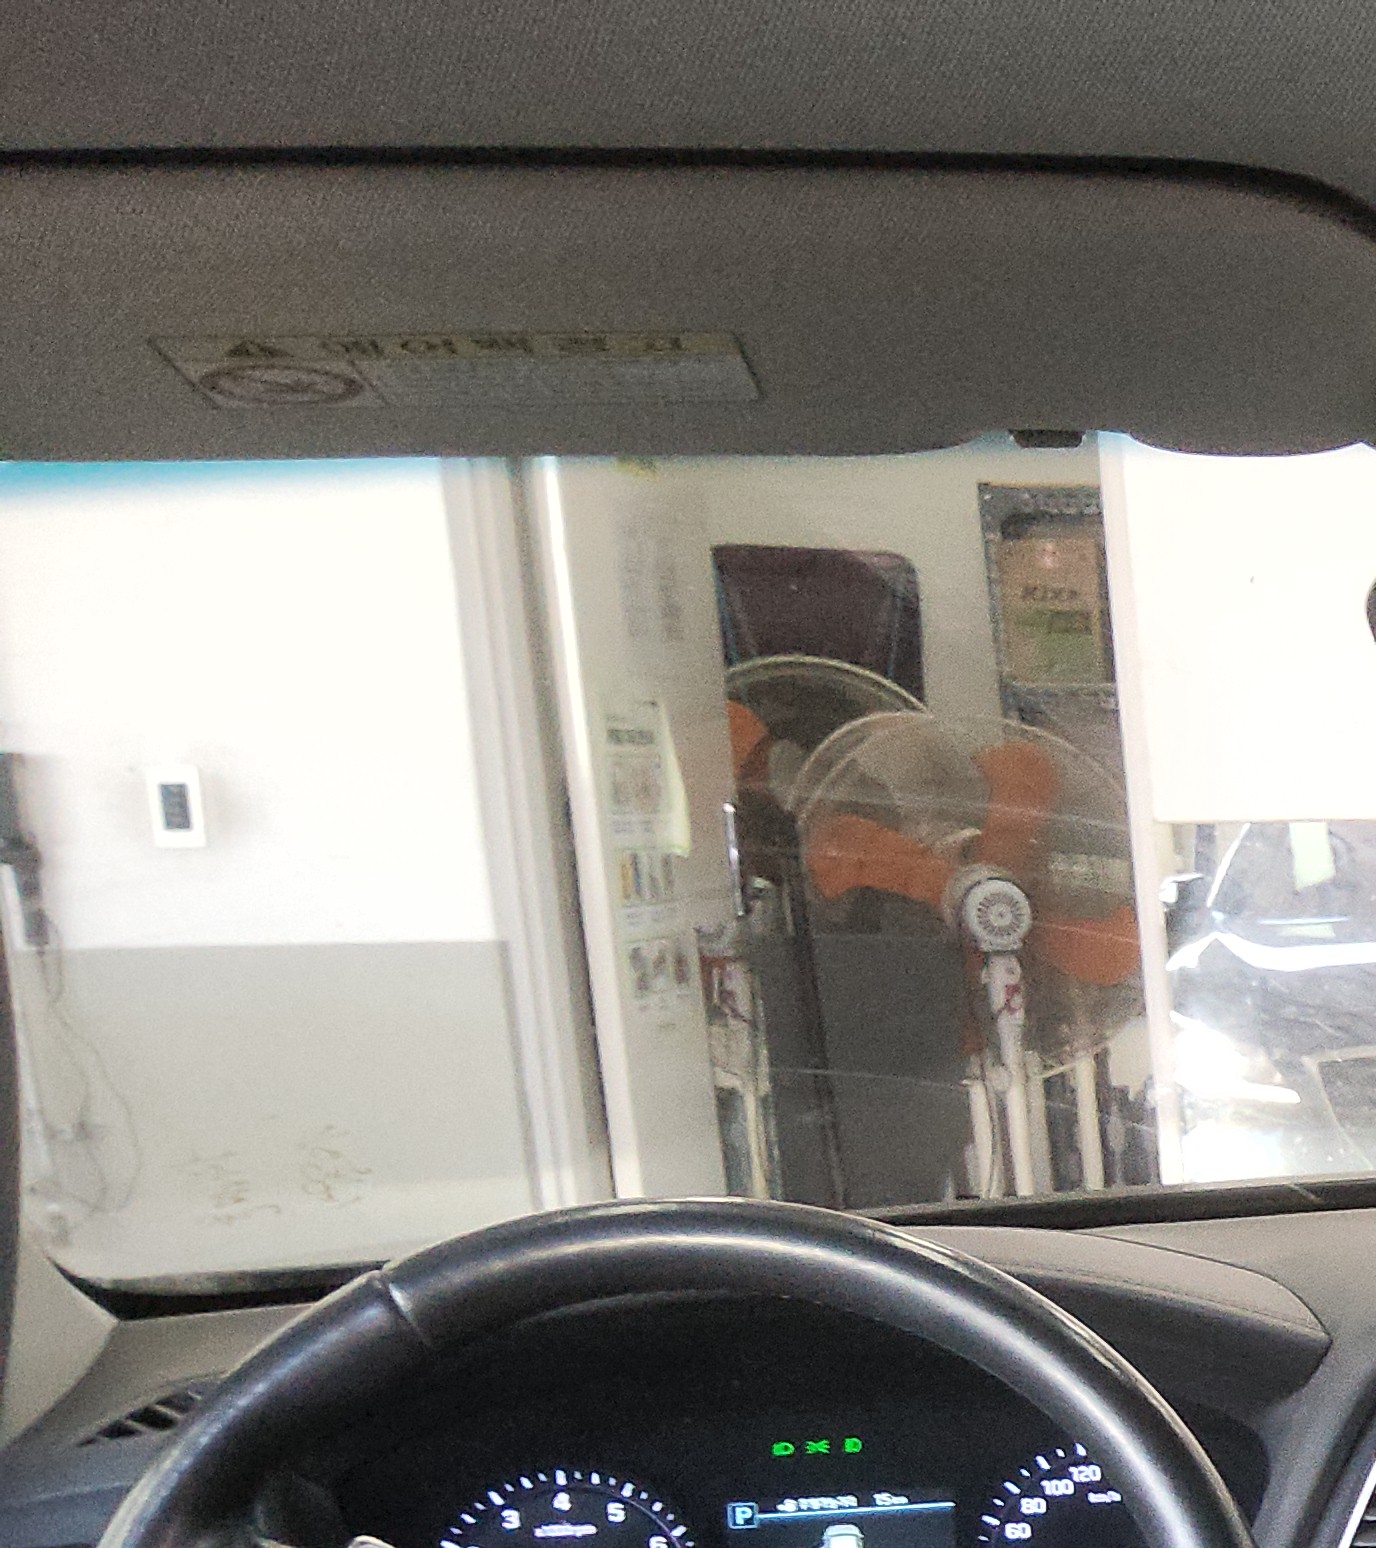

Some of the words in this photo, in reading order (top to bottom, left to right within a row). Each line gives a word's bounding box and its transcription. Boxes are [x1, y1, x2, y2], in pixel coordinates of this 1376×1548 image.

[1068, 1464, 1102, 1483] 120
[1040, 1478, 1075, 1497] 100
[606, 1501, 627, 1523] 5
[735, 1506, 752, 1525] P
[1019, 1497, 1048, 1515] 80
[500, 1508, 522, 1530] 3
[1004, 1522, 1033, 1540] 60
